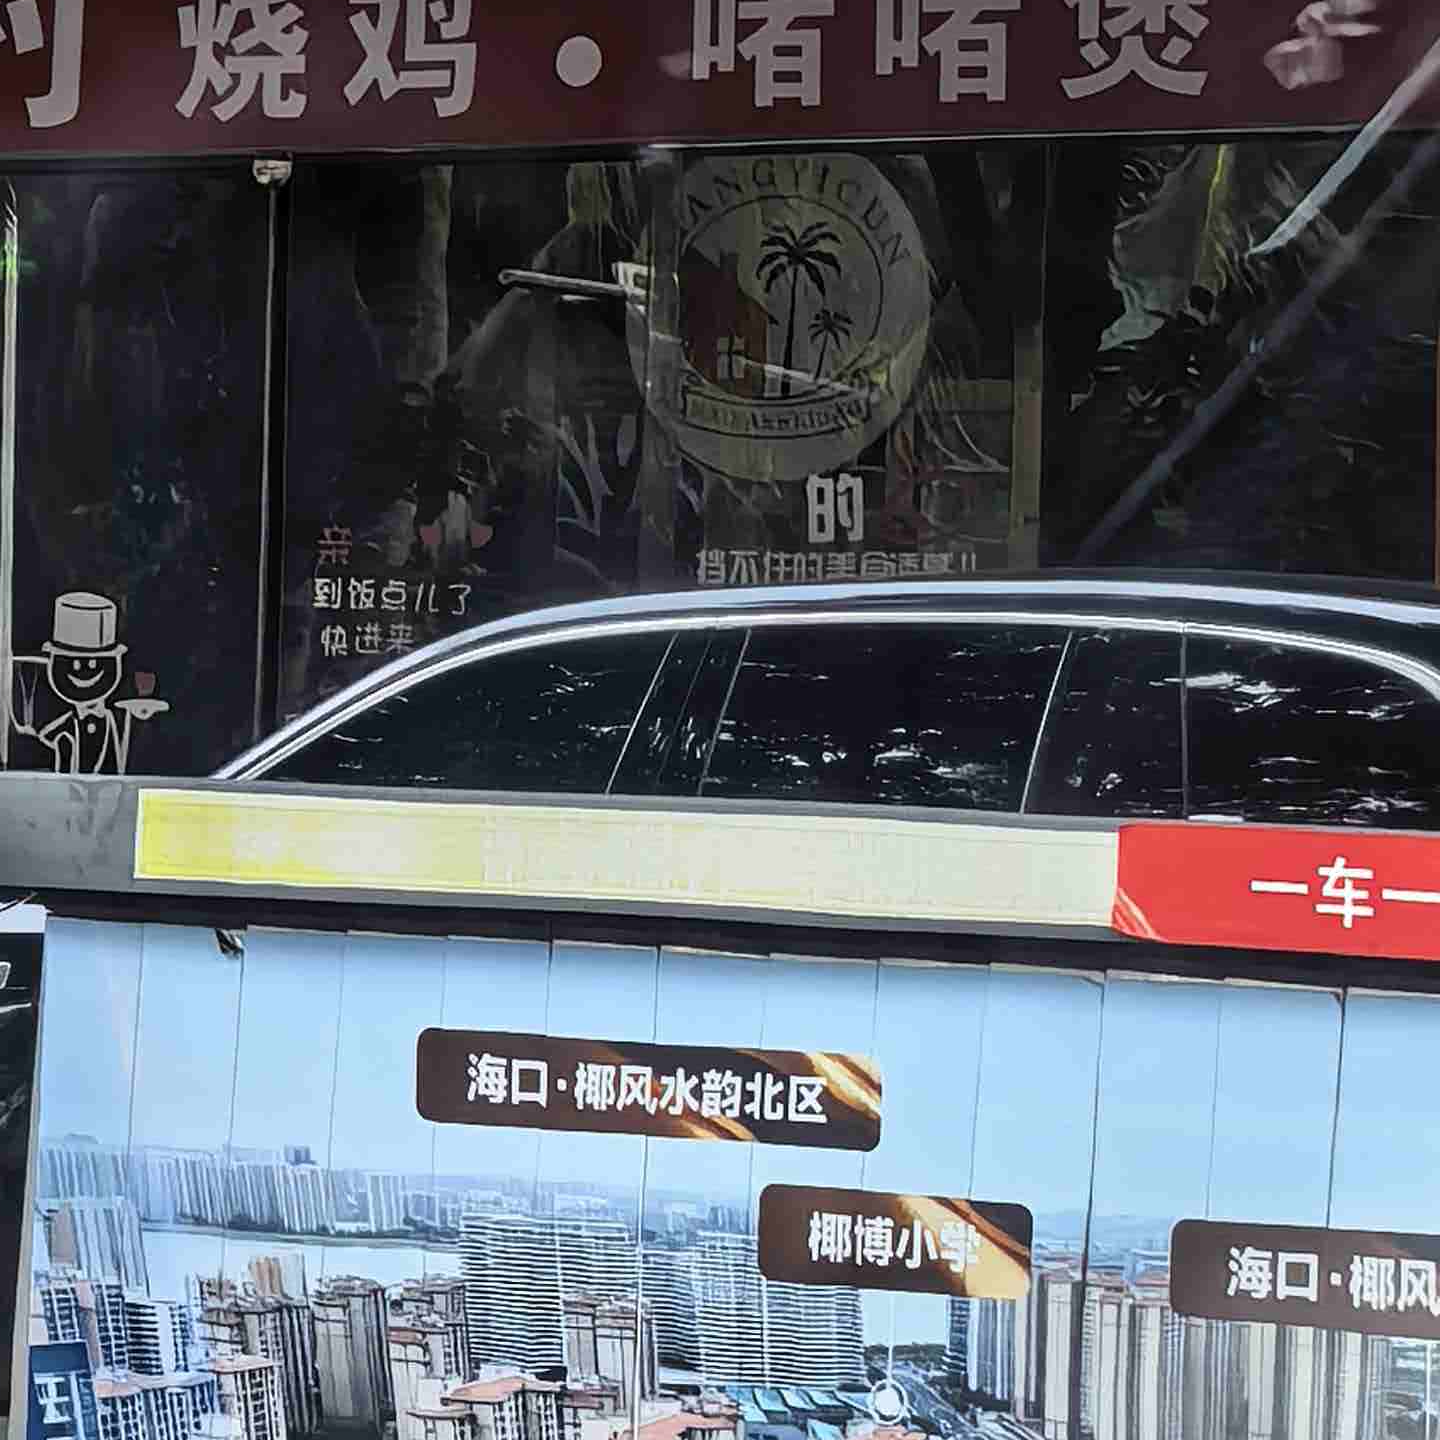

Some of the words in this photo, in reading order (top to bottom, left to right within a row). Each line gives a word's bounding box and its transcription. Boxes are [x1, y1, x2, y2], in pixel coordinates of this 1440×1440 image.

[806, 473, 865, 543] 的
[312, 577, 472, 615] 到饭点儿了
[465, 1052, 828, 1129] 海口·椰风水韵北区
[807, 1211, 981, 1275] 椰博小学
